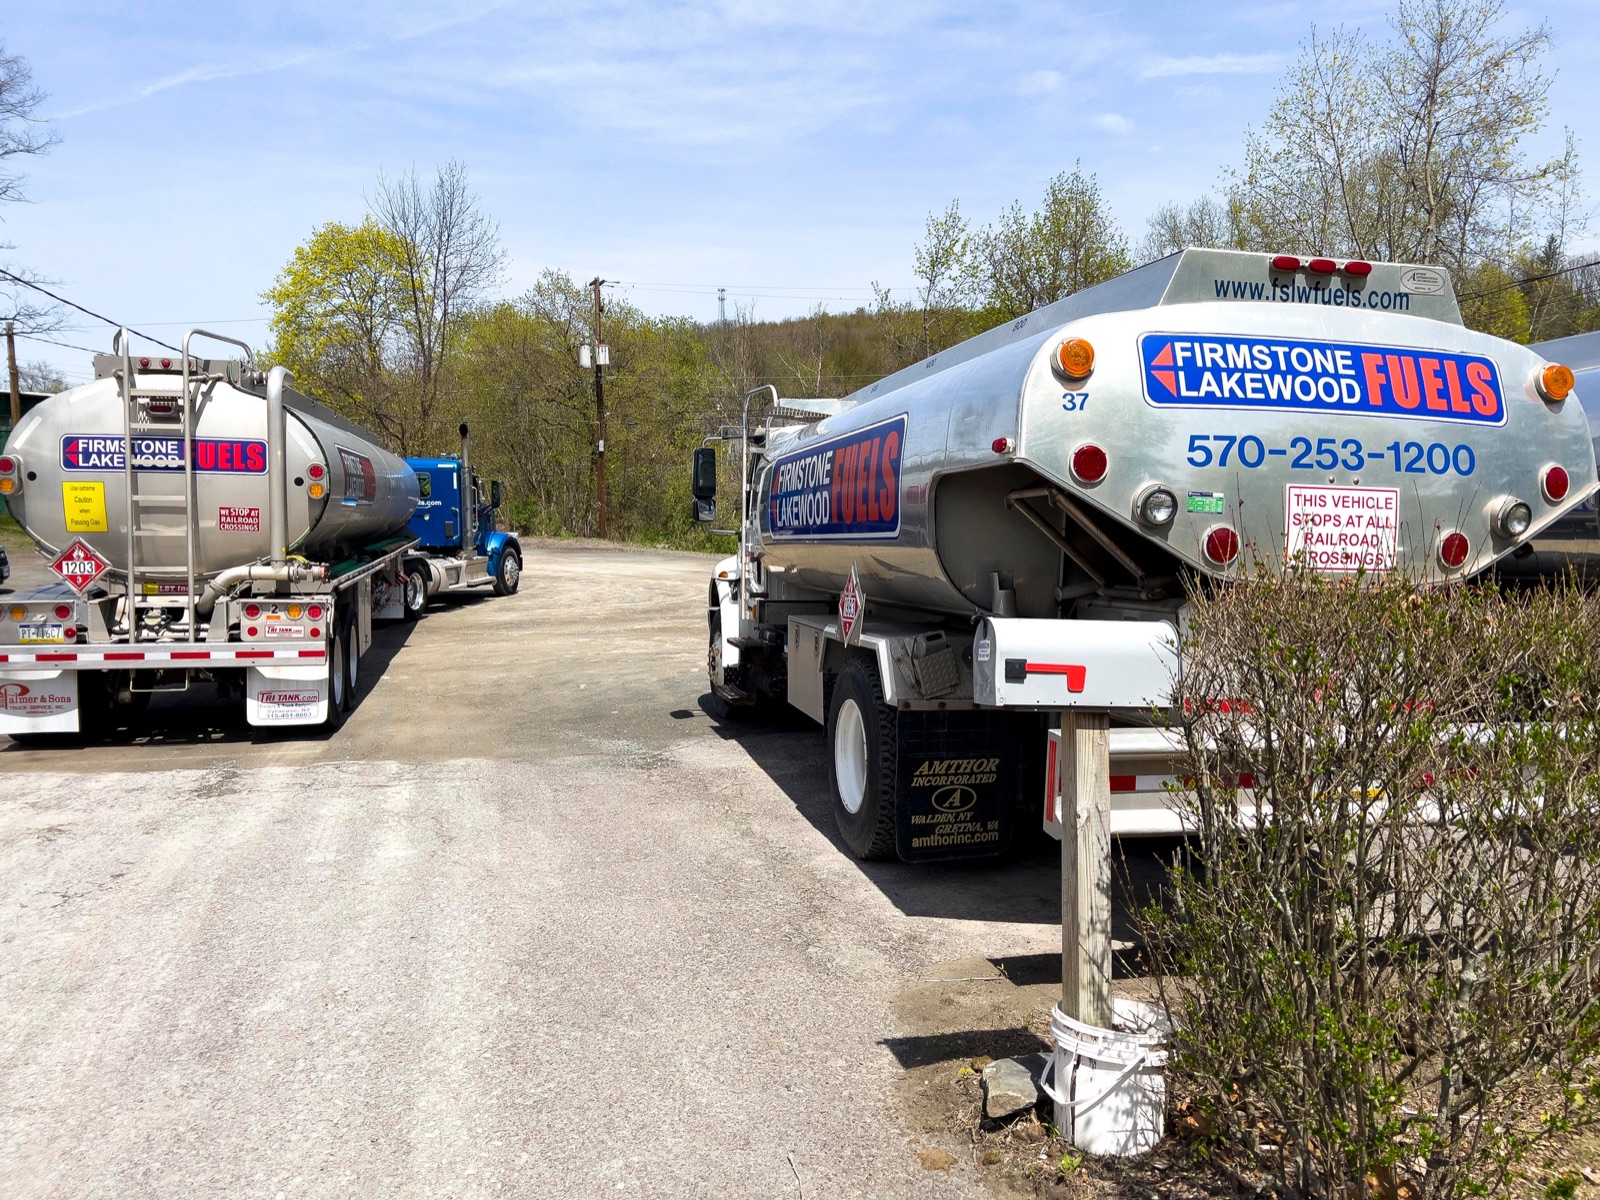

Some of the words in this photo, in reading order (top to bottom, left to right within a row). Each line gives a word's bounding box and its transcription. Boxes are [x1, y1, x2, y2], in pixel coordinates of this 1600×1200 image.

[1214, 277, 1410, 310] www.fslwfuels.com
[1174, 341, 1356, 376] FIRMSTONE
[1361, 352, 1498, 416] FUELS
[1178, 370, 1361, 404] LAKEWOOD
[1062, 392, 1089, 411] 37
[78, 439, 178, 454] FIRMSTONE
[1186, 435, 1476, 476] 570-253-1200
[777, 450, 833, 494] FIRMSTONE
[831, 430, 899, 524] FUELS
[776, 490, 830, 527] LAKEWOOD
[1294, 493, 1327, 507] THIS
[1332, 495, 1393, 510] VEHICLE
[230, 508, 249, 516] STOP
[70, 518, 89, 527] Passing
[220, 516, 258, 524] RAILROAD
[220, 523, 258, 531] CROSSINGS
[1292, 512, 1342, 528] STOPS
[1345, 515, 1363, 528] AT
[1366, 515, 1392, 529] ALL
[1304, 532, 1380, 547] RAILROAD
[65, 562, 93, 574] 1203
[76, 576, 82, 585] 3
[271, 604, 278, 614] 2
[40, 695, 47, 703] &
[48, 694, 72, 703] Sons
[260, 692, 275, 702] TRI
[913, 758, 1000, 775] AMTHOR
[911, 773, 997, 787] INCORPORATED
[942, 788, 961, 807] A
[911, 813, 955, 824] WALDEN,
[957, 811, 974, 821] NY
[935, 822, 984, 834] GRETNA,
[987, 820, 999, 830] VA
[912, 831, 999, 848] amthorinc.com
